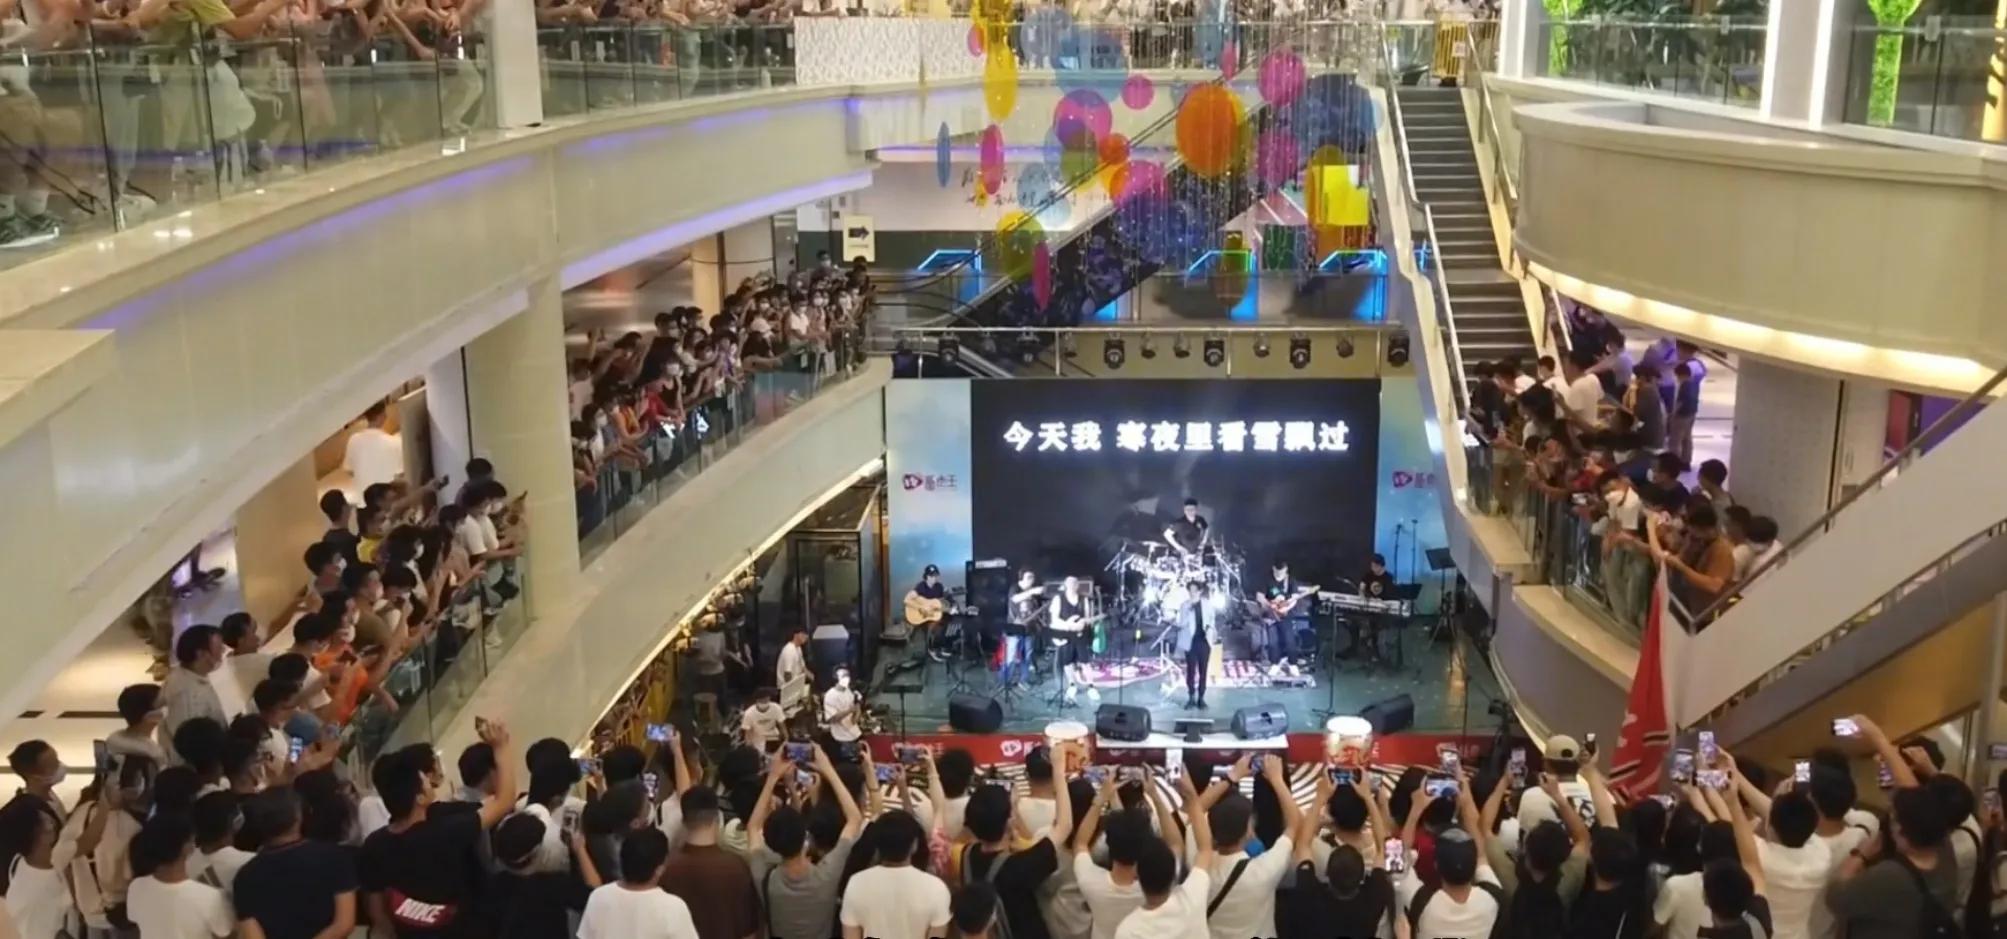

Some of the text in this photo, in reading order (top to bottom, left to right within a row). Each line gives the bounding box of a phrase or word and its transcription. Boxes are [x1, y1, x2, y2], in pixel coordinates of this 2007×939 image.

[1003, 420, 1102, 452] 今天我
[395, 898, 446, 923] NIKE
